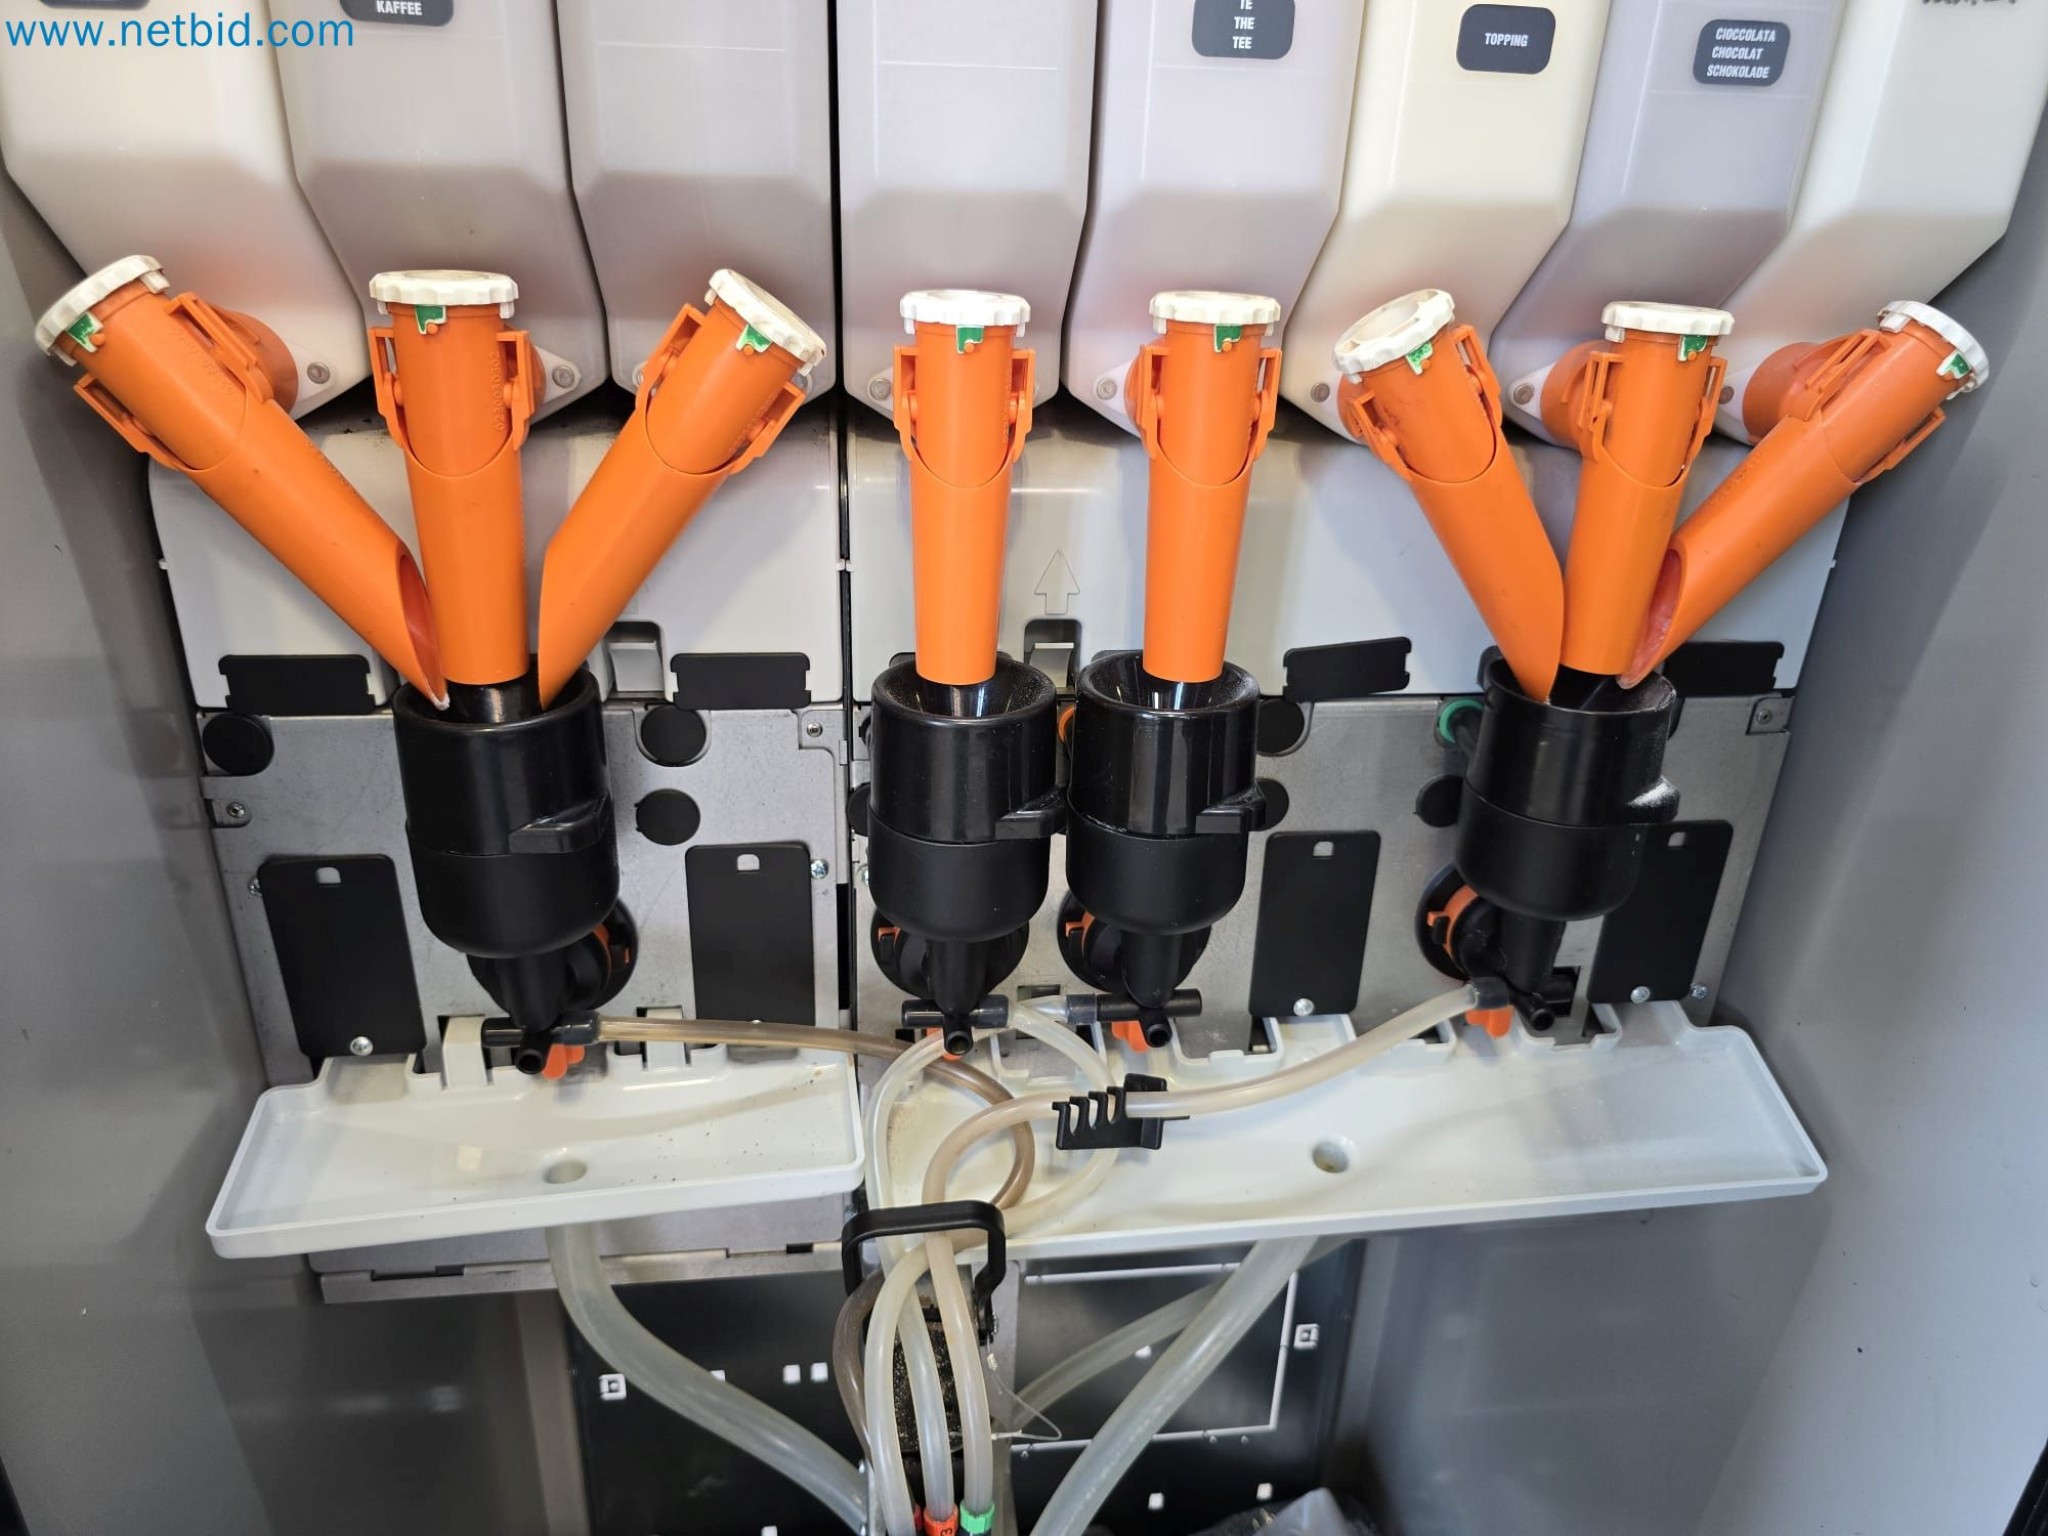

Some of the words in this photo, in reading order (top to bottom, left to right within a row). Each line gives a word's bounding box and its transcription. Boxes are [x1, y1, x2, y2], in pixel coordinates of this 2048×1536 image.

[376, 0, 423, 16] KAFFEE
[1233, 16, 1255, 30] THE
[1232, 35, 1252, 49] TEE
[1484, 32, 1529, 47] TOPPING
[1715, 27, 1777, 43] CIOCCOLATA
[1711, 46, 1764, 60] CHOCOLAT
[1706, 64, 1770, 79] SCHOKOLADE
